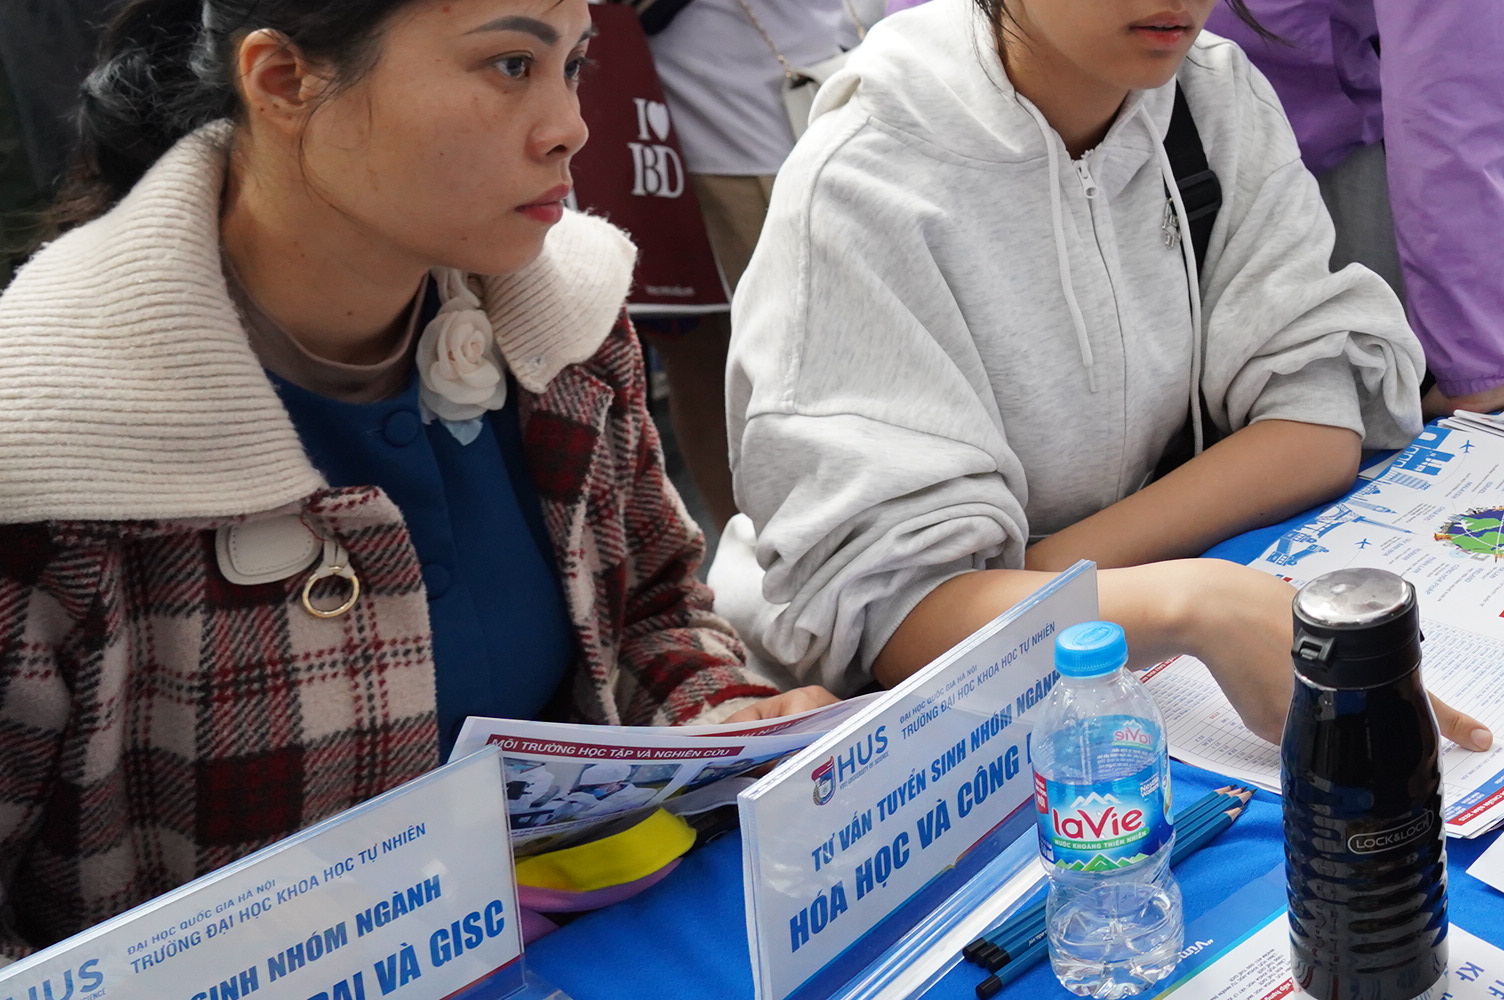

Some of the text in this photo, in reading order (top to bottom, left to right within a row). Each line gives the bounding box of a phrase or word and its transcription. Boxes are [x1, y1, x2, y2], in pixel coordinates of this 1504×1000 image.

[901, 621, 1056, 740] TRƯỜNG ĐẠI HỌC KHOA HỌC TỰ NHIÊN
[522, 740, 576, 756] TRƯỜNG
[578, 746, 606, 760] HỌC
[608, 746, 635, 760] TẬP
[636, 747, 654, 759] VÀ
[654, 747, 702, 759] NGHIÊN
[703, 745, 732, 758] CỨU
[811, 833, 836, 873] TƯ
[838, 808, 873, 845] VẤN
[876, 767, 927, 824] TUYỂN
[931, 746, 967, 783] SINH
[970, 705, 1013, 753] NHÓM
[837, 725, 889, 783] HUS
[789, 880, 849, 954] HÓA
[855, 830, 910, 902] HỌC
[916, 799, 952, 850] VÀ
[957, 743, 1020, 819] CÔNG
[1052, 806, 1143, 839] laVie
[1072, 841, 1102, 850] KHOÁNG
[1104, 838, 1126, 848] THIÊN
[1356, 819, 1430, 849] LOCK&LOCK
[127, 878, 276, 956] ĐẠI HỌC QUỐC GIA HÀ NỘI
[130, 822, 427, 975] TRƯỜNG ĐẠI HỌC KHOA HỌC TỰ NHIÊN
[267, 920, 348, 984] NHÓM
[354, 874, 442, 938] NGÀNH
[374, 941, 423, 998] VÀ
[428, 898, 505, 970] GISC
